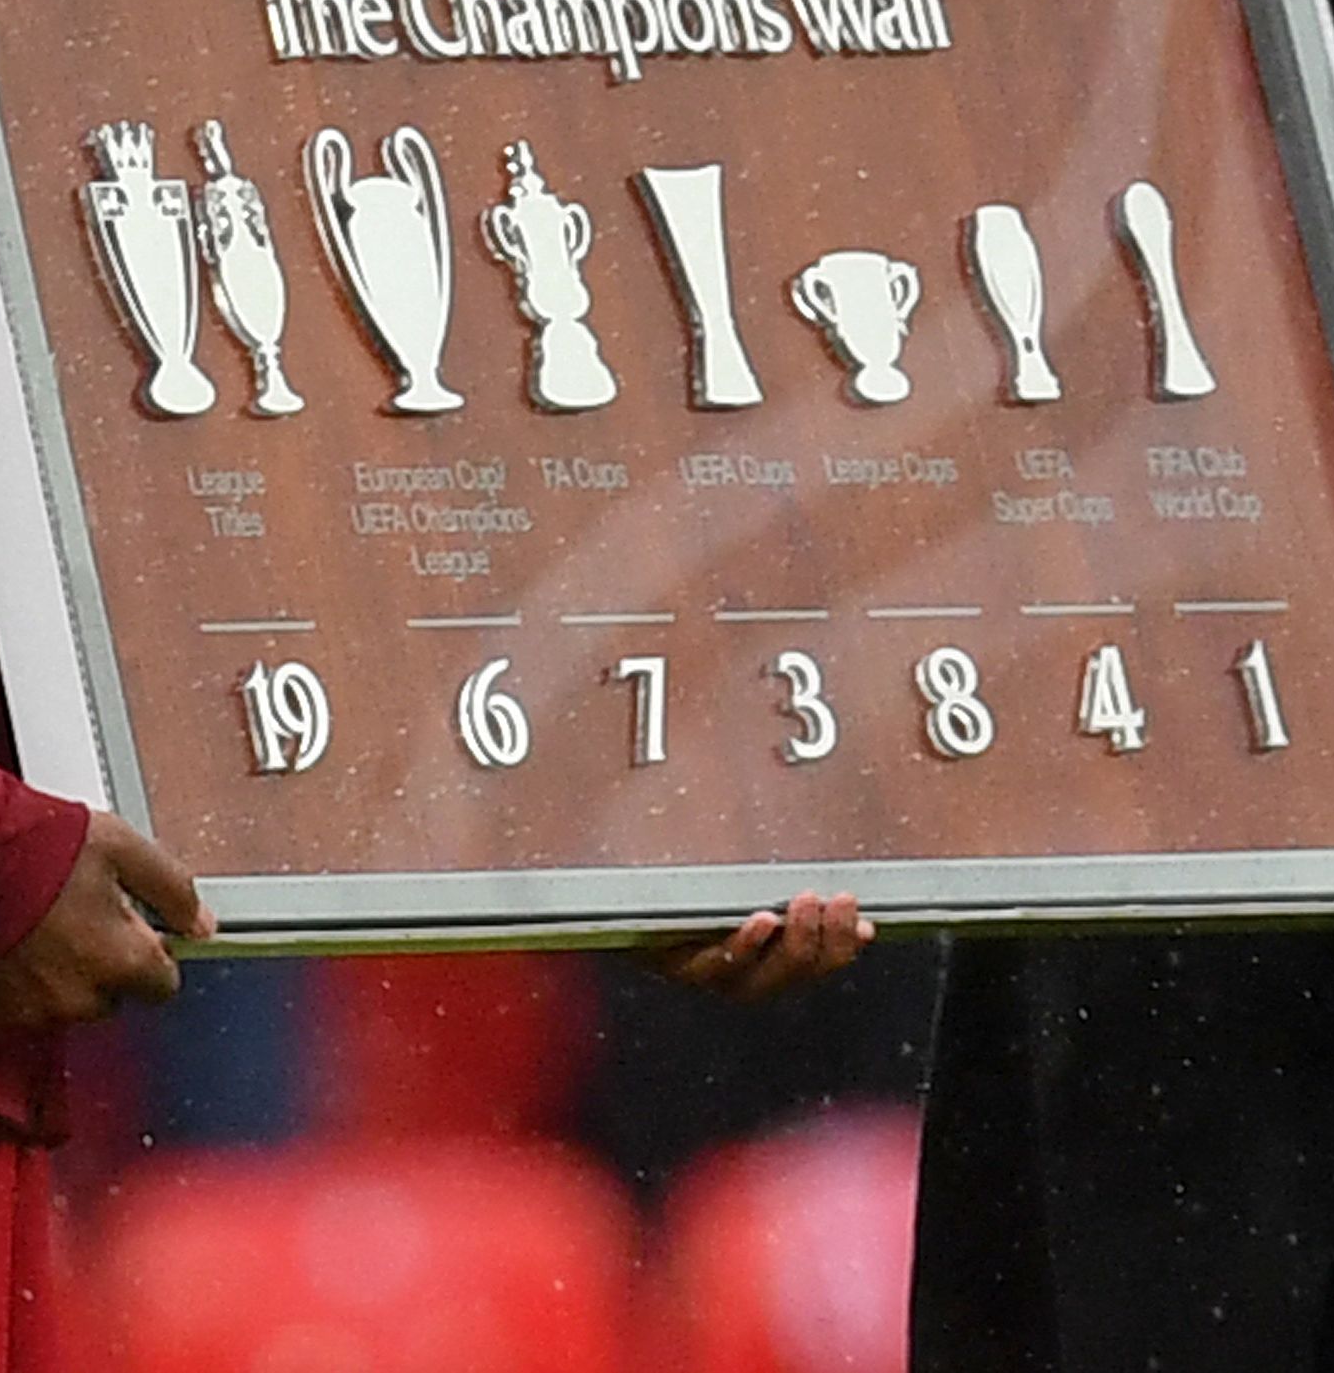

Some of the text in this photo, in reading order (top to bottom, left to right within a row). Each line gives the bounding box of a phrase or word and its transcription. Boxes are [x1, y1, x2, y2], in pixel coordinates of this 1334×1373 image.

[353, 462, 455, 495] European
[539, 458, 573, 488] FA
[678, 453, 739, 486] UEFA
[821, 452, 959, 490] League Cups
[1015, 449, 1075, 480] UEFA
[1146, 447, 1197, 477] FIFA
[186, 466, 267, 502] League
[204, 504, 266, 538] Titles
[350, 503, 532, 539] UEFA Champions
[991, 490, 1057, 525] Super
[1147, 486, 1263, 523] World Cup
[411, 546, 492, 581] League
[457, 657, 531, 767] 6
[613, 656, 667, 765] 7
[773, 650, 839, 761] 3
[915, 645, 995, 758] 8
[1078, 644, 1145, 753] 4
[1235, 638, 1290, 750] 1
[240, 660, 331, 772] 19
